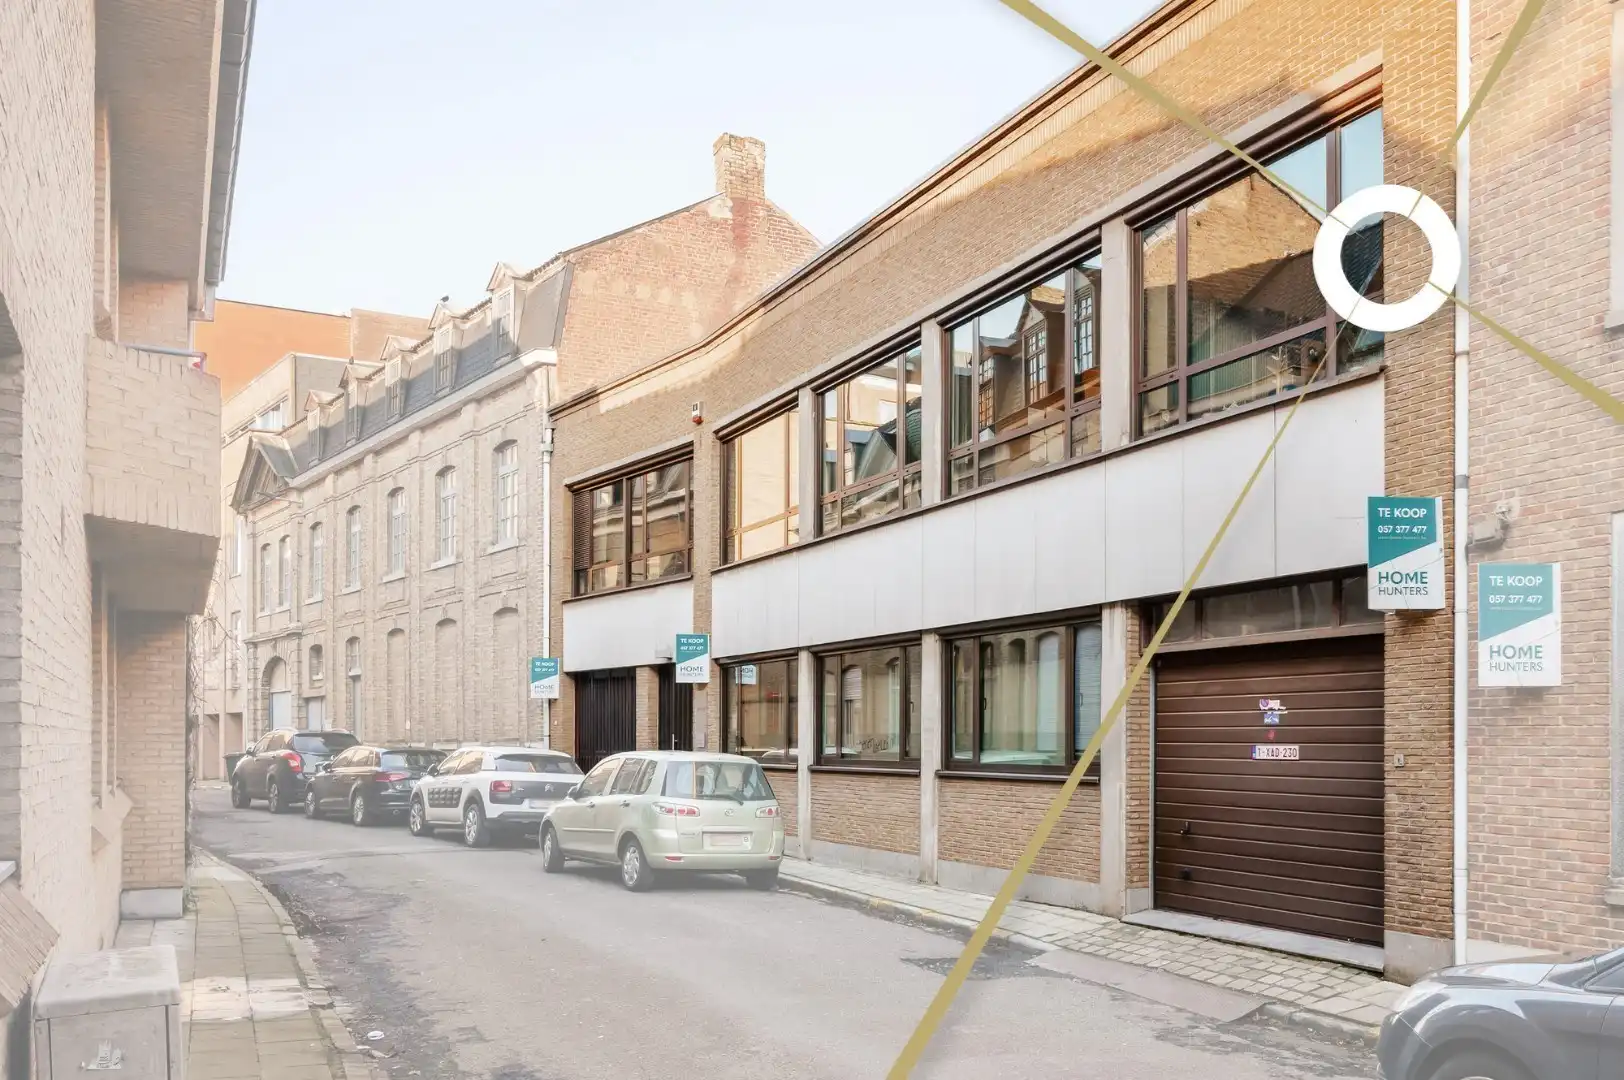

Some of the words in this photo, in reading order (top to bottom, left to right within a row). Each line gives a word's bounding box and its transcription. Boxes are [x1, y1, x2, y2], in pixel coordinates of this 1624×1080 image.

[1378, 507, 1390, 518] TE
[1394, 507, 1427, 519] KOOP
[1378, 525, 1393, 533] 057
[1395, 525, 1409, 533] 377
[1412, 525, 1427, 533] 477
[1378, 571, 1428, 584] HOME
[1489, 575, 1503, 586] TE
[1507, 576, 1543, 587] KOOP
[1378, 586, 1428, 596] HUNTERS
[1489, 595, 1505, 604] 057
[1508, 595, 1523, 604] 377
[1526, 595, 1542, 604] 477
[1489, 645, 1543, 659] HOME
[1489, 661, 1543, 672] HUNTERS
